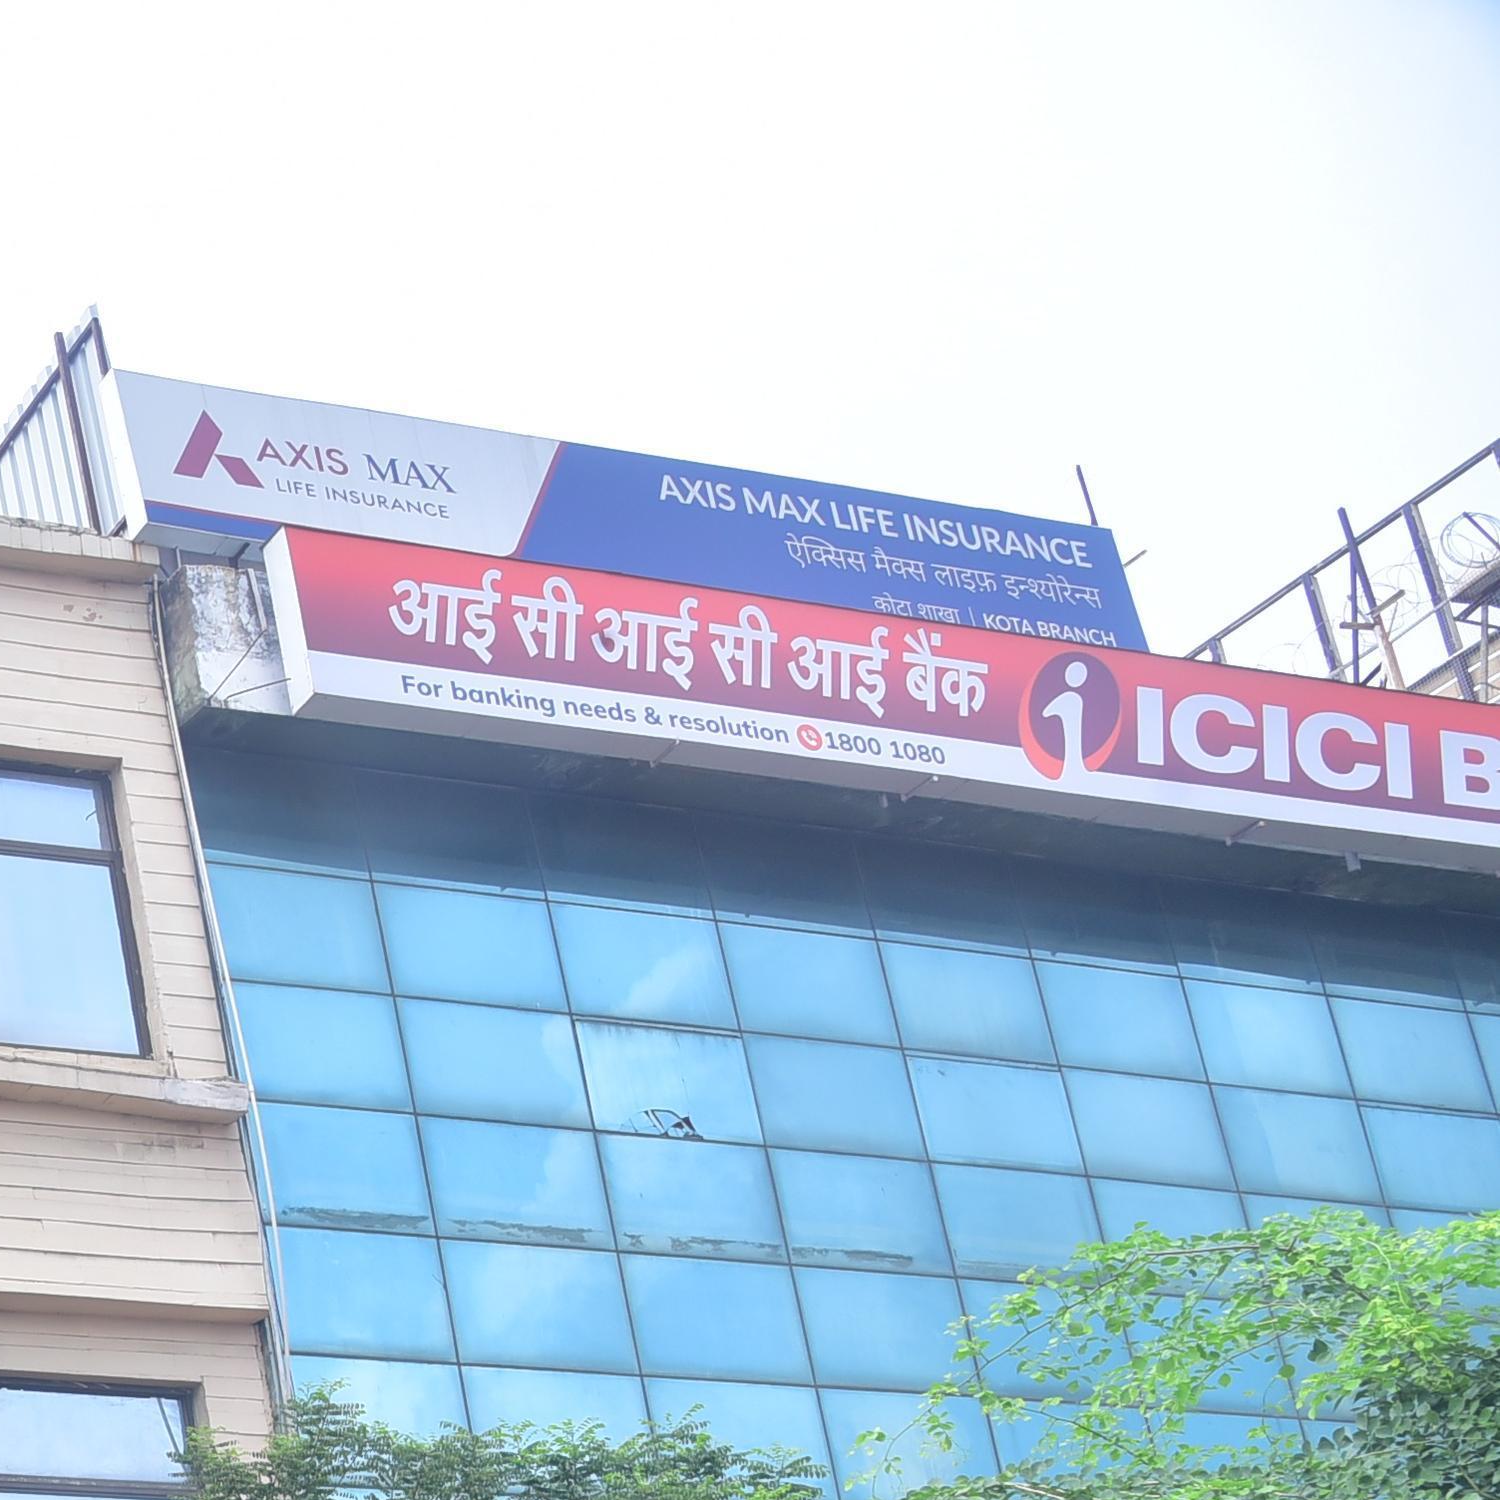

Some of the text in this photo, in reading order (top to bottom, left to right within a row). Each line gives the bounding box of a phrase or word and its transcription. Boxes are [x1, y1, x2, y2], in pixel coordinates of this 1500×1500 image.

[256, 438, 457, 495] AXIS MAX
[275, 478, 450, 520] LIFE INSURANCE
[659, 474, 1093, 568] AXIS MAX LIFE INSURANCE
[871, 547, 924, 583] मैक्स
[388, 569, 988, 718] आई सी आई सी आई बैंक
[873, 594, 1116, 648] कोटा शाखा KOTA BRANCH
[400, 674, 945, 766] For banking needs & resolution 1800 1080
[1136, 685, 1414, 800] ICICI
